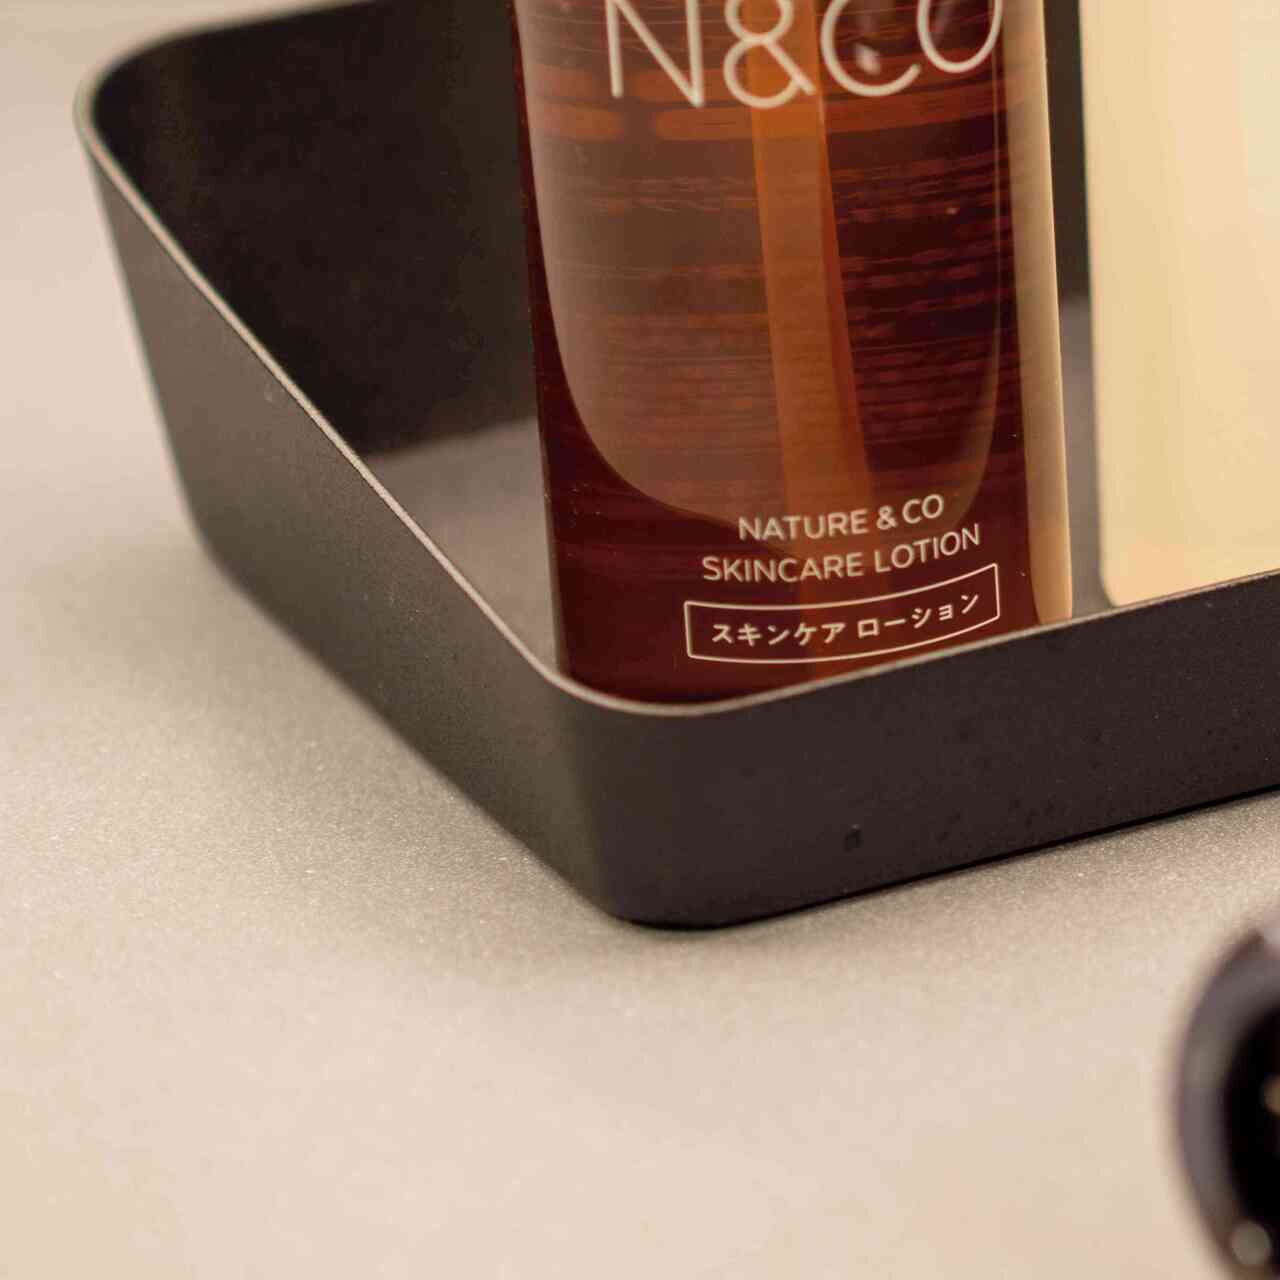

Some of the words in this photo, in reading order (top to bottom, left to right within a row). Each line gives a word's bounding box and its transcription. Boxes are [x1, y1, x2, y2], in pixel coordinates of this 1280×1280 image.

[739, 509, 868, 541] NATURE
[876, 505, 897, 530] &
[902, 494, 943, 525] CO
[702, 551, 863, 583] SKINCARE
[874, 523, 980, 574] LOTION
[712, 621, 845, 647] スキンケア
[857, 593, 979, 638] ローション
